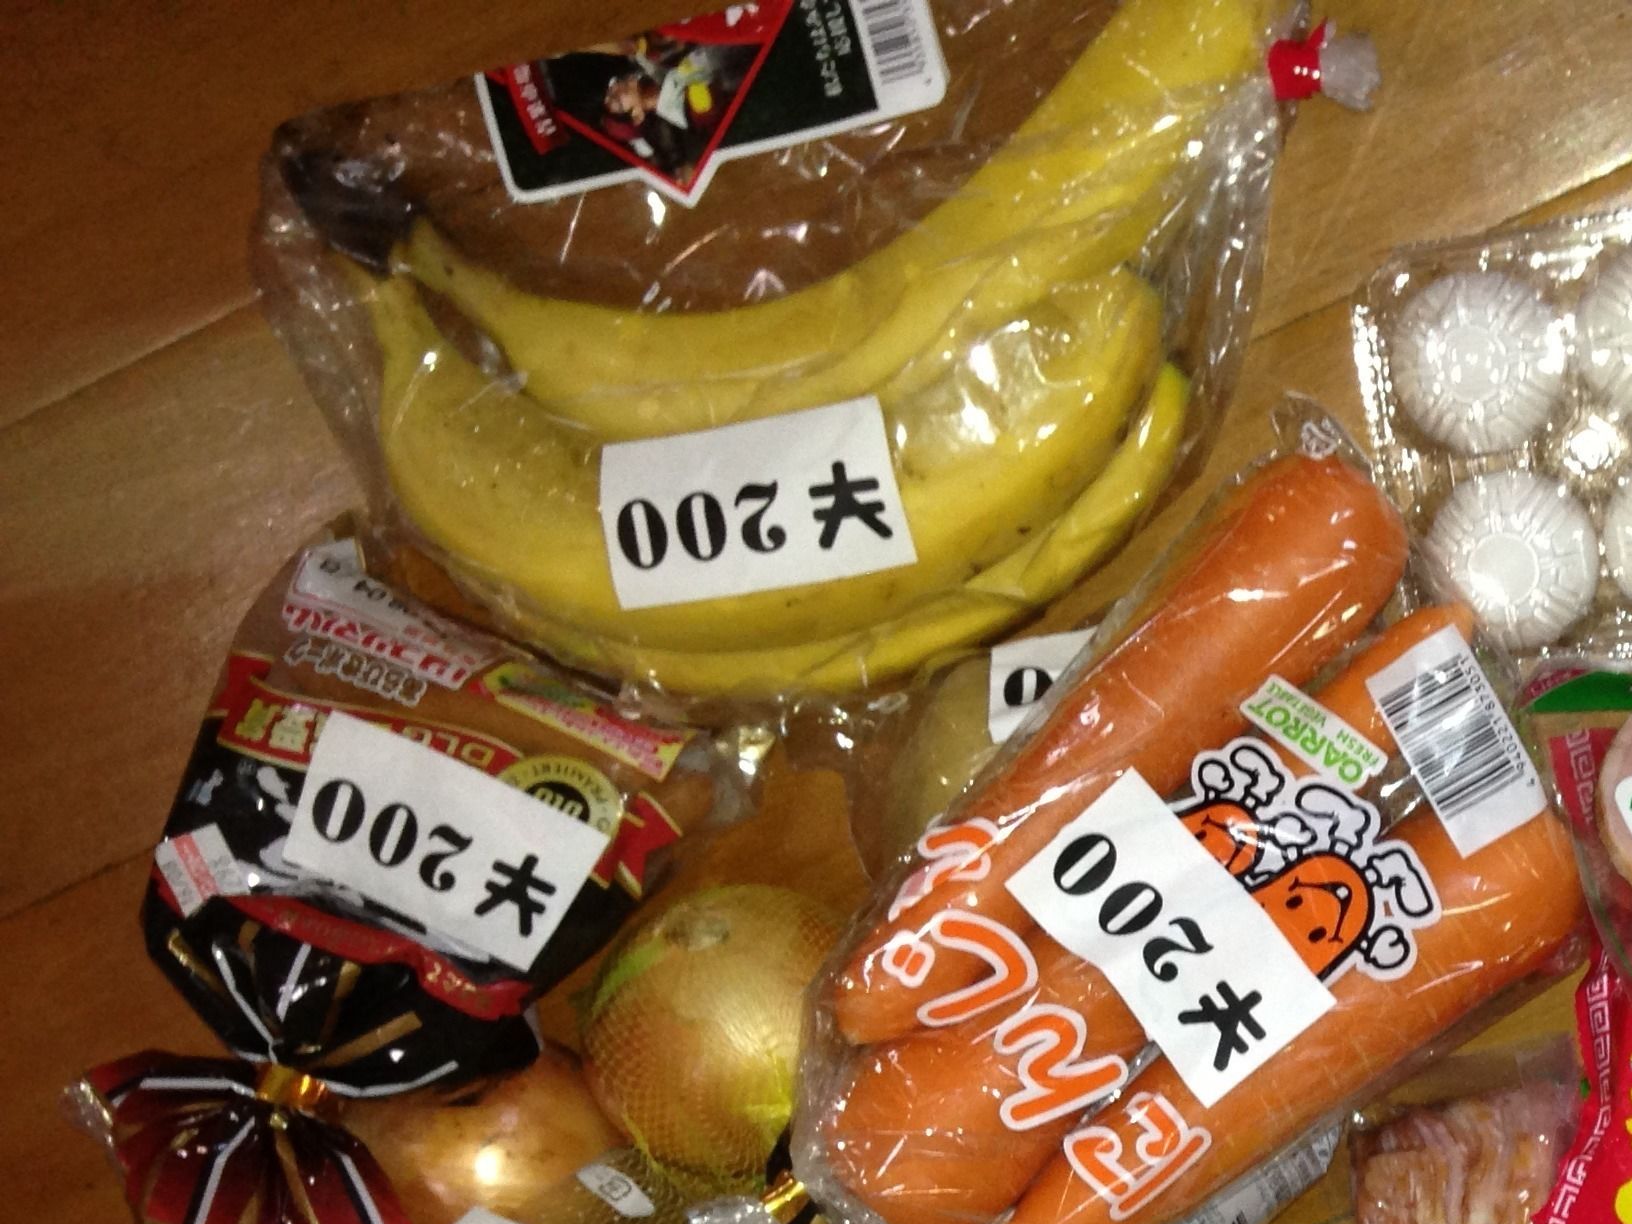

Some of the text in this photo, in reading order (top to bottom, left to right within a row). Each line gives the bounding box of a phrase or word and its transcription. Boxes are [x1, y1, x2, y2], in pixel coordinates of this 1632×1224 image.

[617, 460, 892, 570] ¥200
[1246, 697, 1364, 785] CARROT
[1335, 725, 1379, 766] FRESH
[311, 778, 555, 938] ¥200
[1051, 831, 1266, 1071] ¥200
